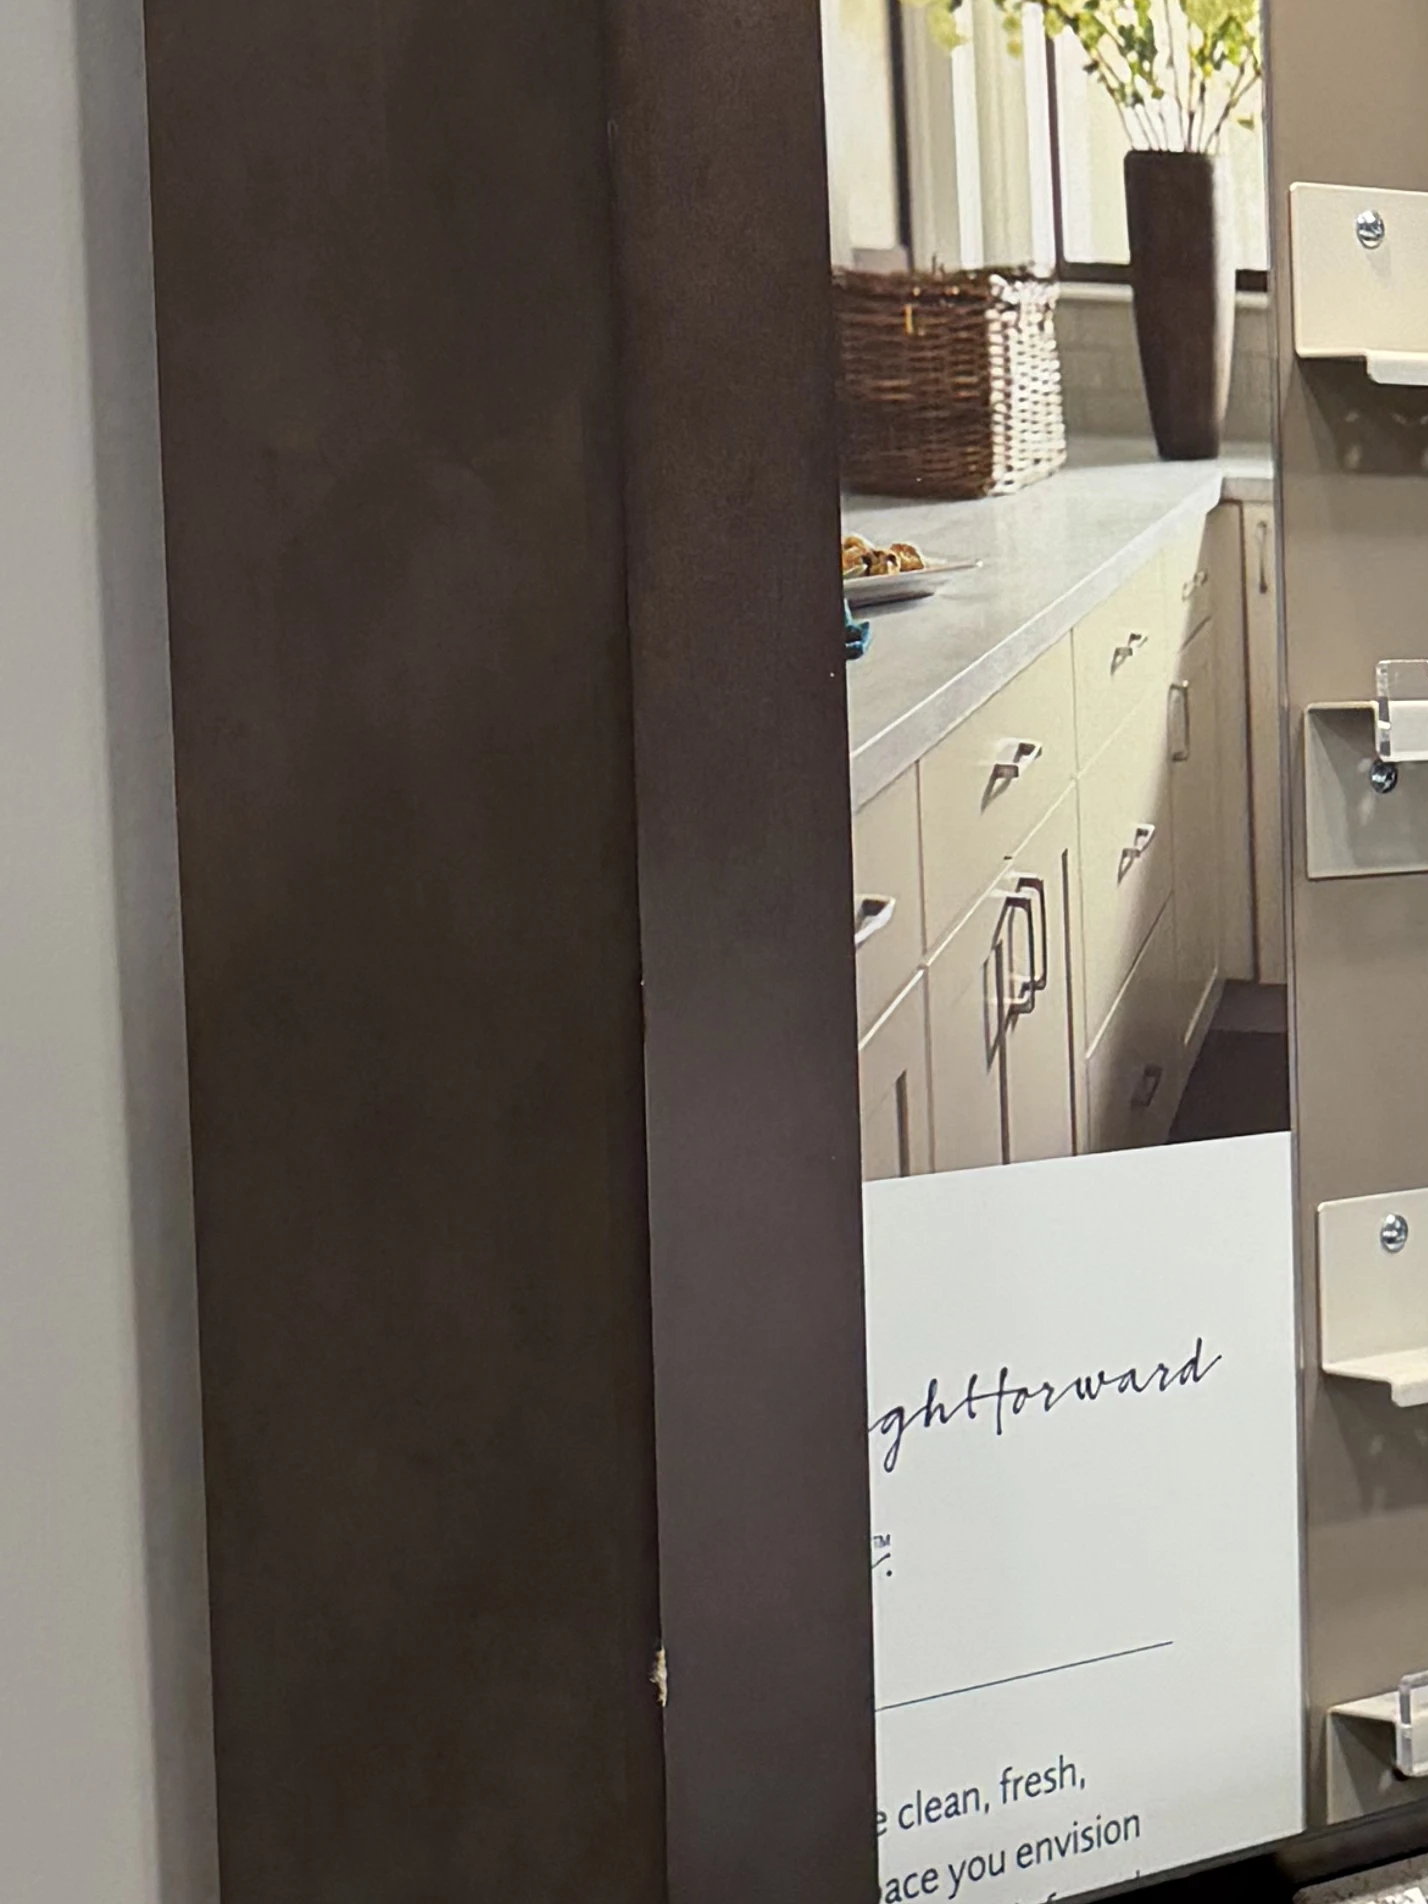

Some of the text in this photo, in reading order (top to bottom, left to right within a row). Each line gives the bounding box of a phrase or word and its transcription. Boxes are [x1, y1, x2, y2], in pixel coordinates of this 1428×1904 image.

[869, 1337, 1222, 1472] ghtforward
[898, 1789, 990, 1830] clean,
[1000, 1754, 1085, 1805] fresh,
[879, 1866, 938, 1904] ace
[948, 1851, 1006, 1900] you
[1016, 1814, 1140, 1870] envision
